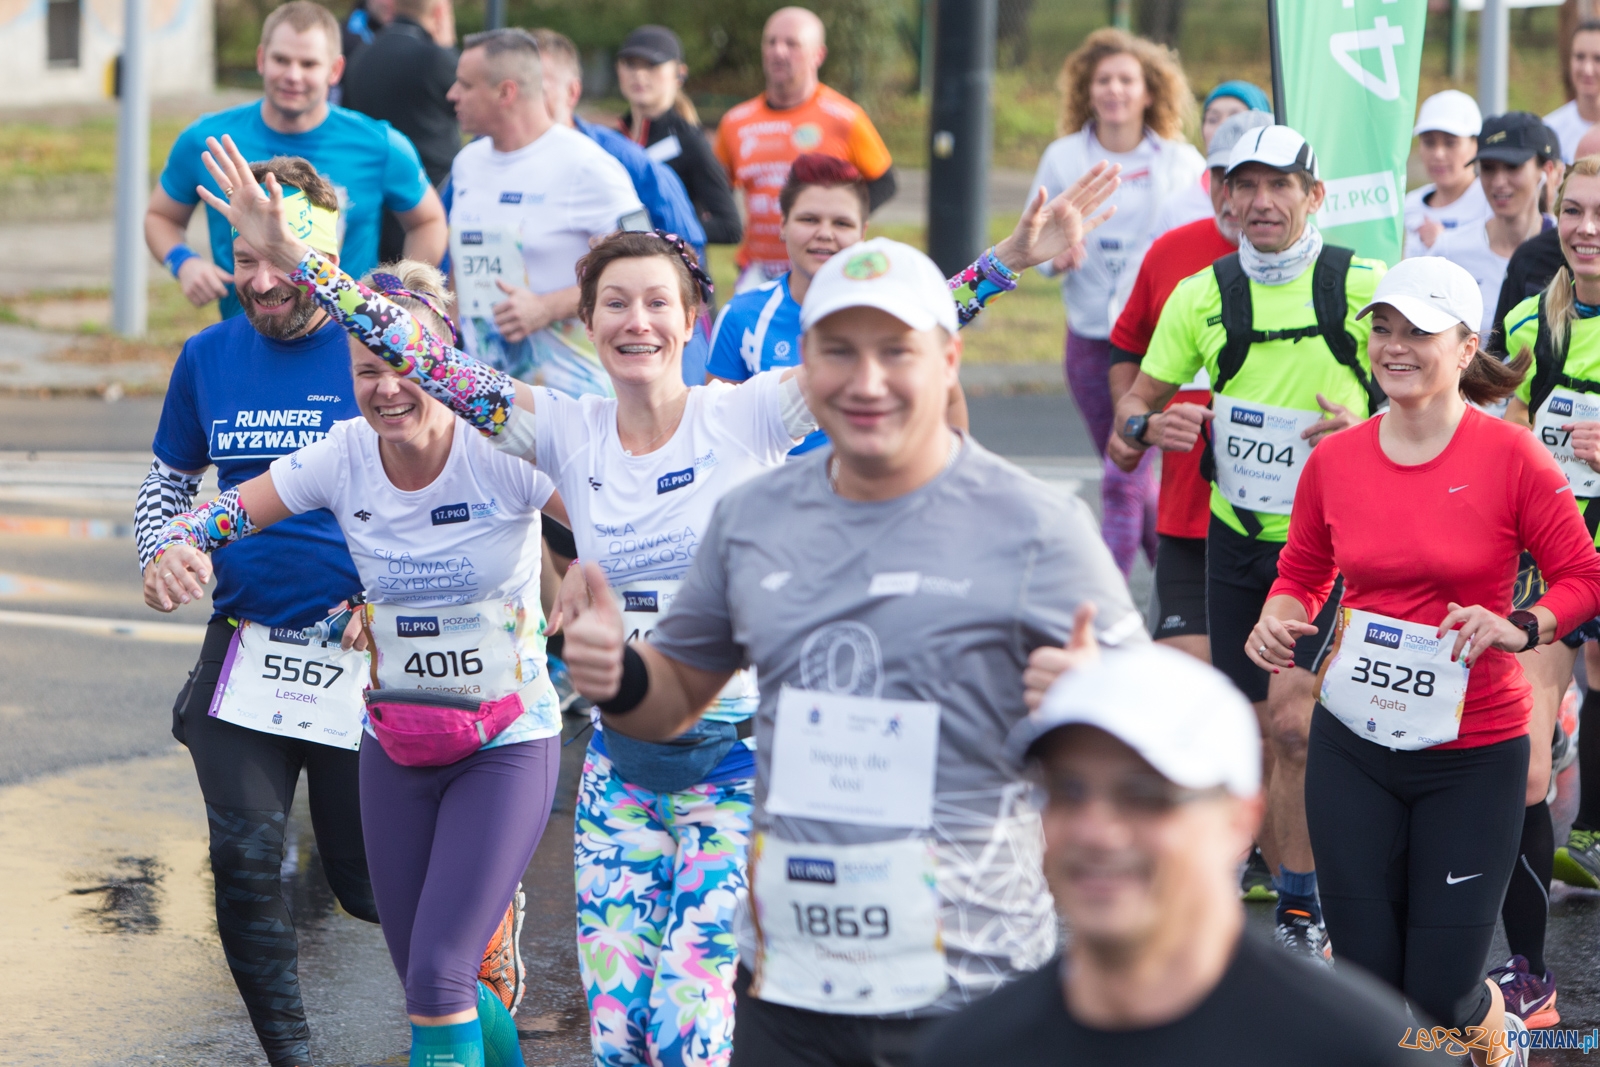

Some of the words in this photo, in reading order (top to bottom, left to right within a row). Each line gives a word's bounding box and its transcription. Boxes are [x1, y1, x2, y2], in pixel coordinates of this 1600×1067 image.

[463, 255, 503, 276] 3714
[307, 394, 334, 402] CRAFT
[235, 409, 323, 428] RUNNER'S
[1232, 410, 1263, 425] 17.PKO
[1541, 426, 1572, 447] 67
[1227, 435, 1295, 467] 6704
[659, 471, 693, 489] 17.PKO
[1233, 463, 1282, 482] Mirosław
[433, 508, 468, 520] 17.PKO
[608, 526, 697, 555] ODWAGA
[388, 556, 474, 575] ODWAGA
[377, 570, 479, 590] SZYBKOŚĆ
[399, 620, 436, 632] 17.PKO
[443, 621, 481, 632] maraton
[1368, 628, 1399, 644] 17.PKO
[1403, 641, 1438, 654] maraton
[262, 654, 344, 689] 5567
[404, 648, 483, 678] 4016
[1351, 656, 1436, 697] 3528
[275, 688, 318, 705] Leszek
[1370, 694, 1407, 712] Agata
[790, 900, 890, 939] 1869
